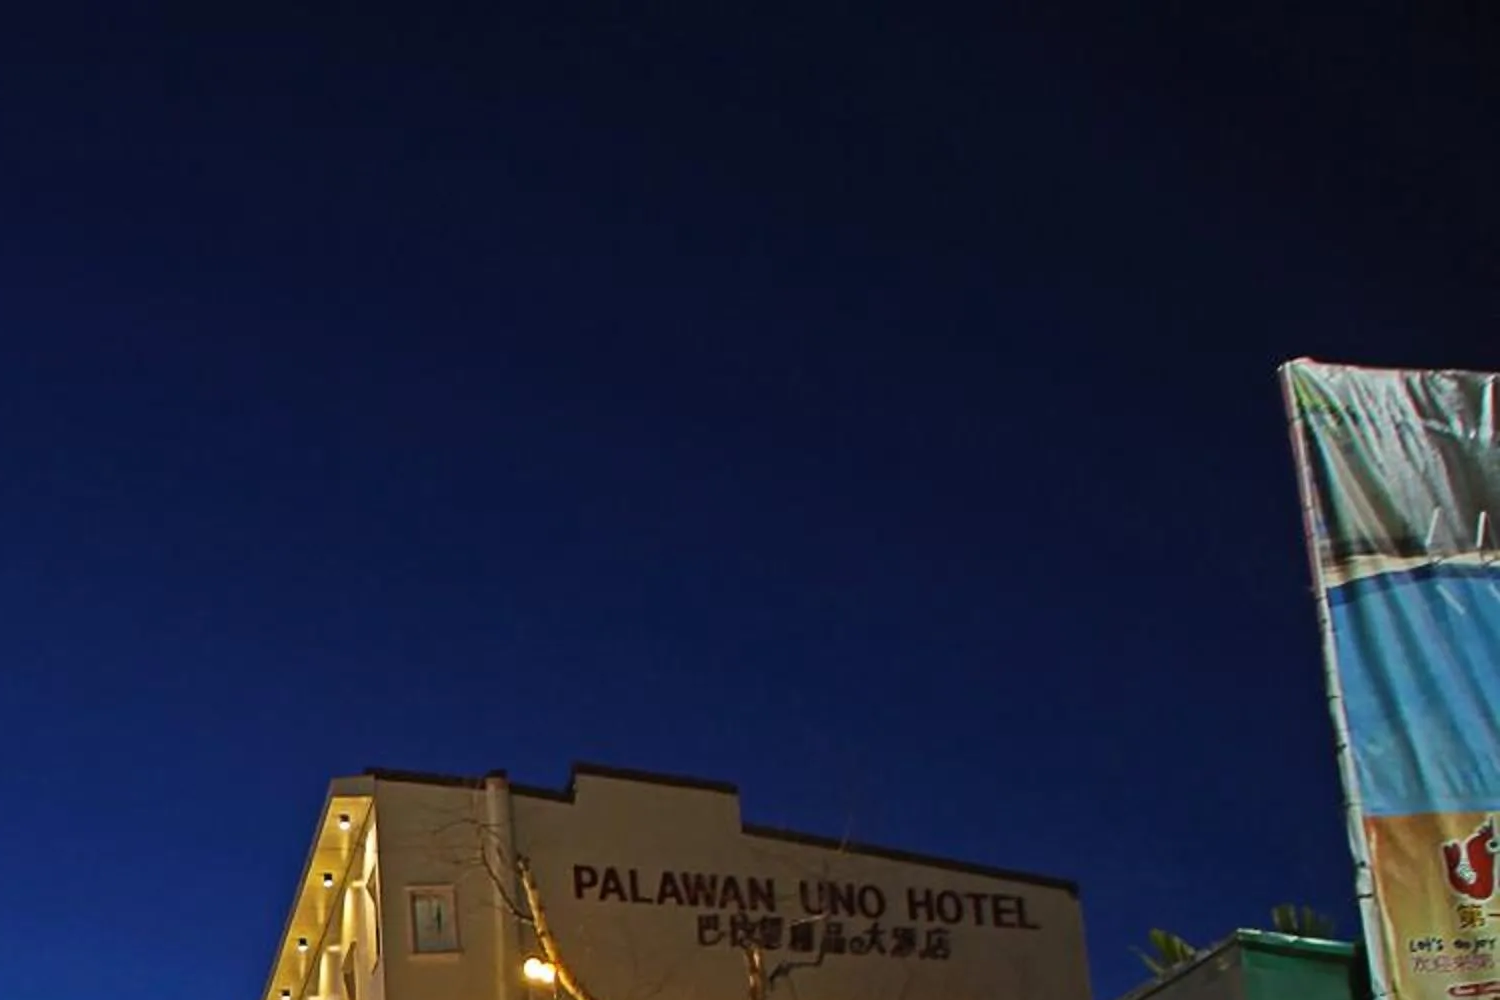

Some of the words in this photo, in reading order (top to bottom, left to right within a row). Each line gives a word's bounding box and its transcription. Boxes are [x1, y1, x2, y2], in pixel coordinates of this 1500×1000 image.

[572, 864, 776, 913] PALAWAN
[799, 879, 886, 919] UNO
[906, 888, 1041, 930] HOTEL
